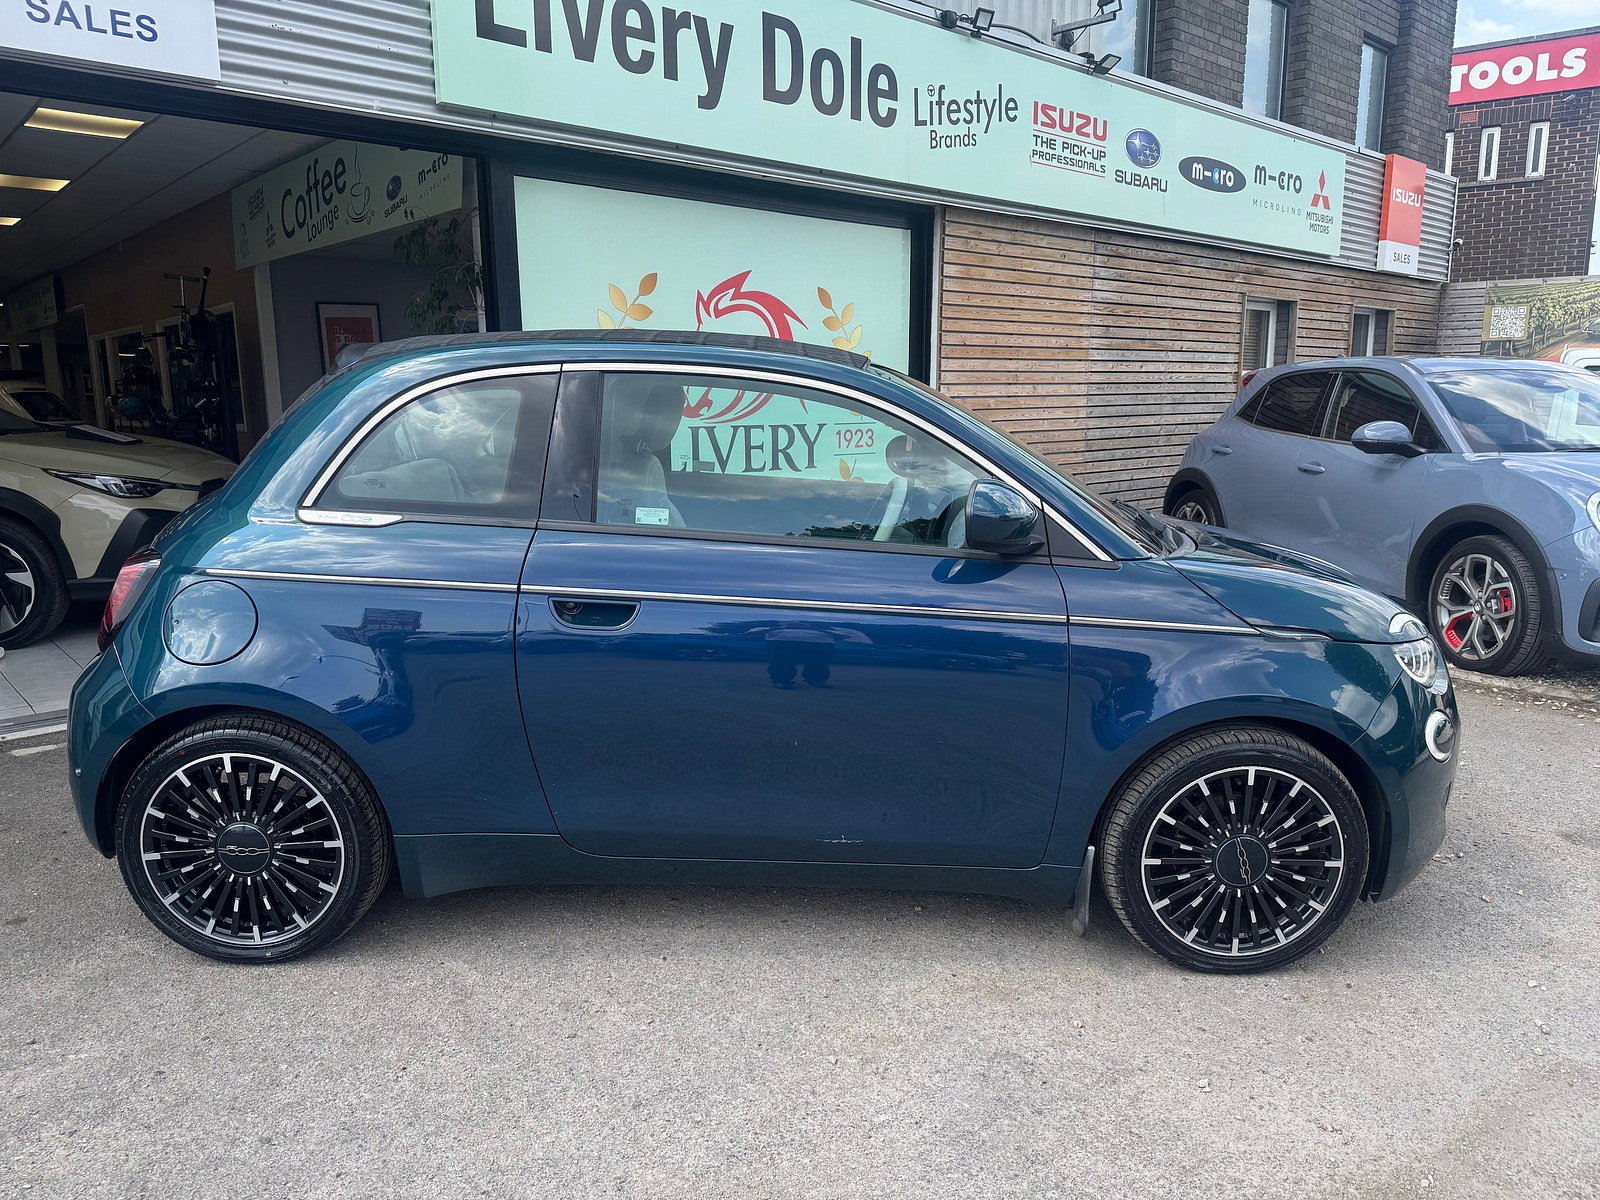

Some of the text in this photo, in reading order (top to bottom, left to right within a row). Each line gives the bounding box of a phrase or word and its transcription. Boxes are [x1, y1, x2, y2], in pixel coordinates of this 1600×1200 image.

[25, 0, 159, 42] SALES
[761, 11, 899, 128] Dole
[1450, 47, 1588, 93] TOOLS
[913, 83, 1019, 133] Lifestyle
[1032, 100, 1108, 142] ISUZU
[930, 128, 977, 150] Brands
[1032, 134, 1107, 161] THE PICK-UP
[1031, 148, 1106, 174] PROFESSIONALS
[1114, 168, 1168, 193] SUBARU
[281, 156, 347, 239] Coffee
[384, 194, 408, 218] SUBARU
[1252, 198, 1303, 217] MICROLINO
[1392, 187, 1421, 208] ISUZU
[307, 204, 339, 242] Lounge
[1305, 210, 1334, 226] MITSUBISHI
[1309, 222, 1330, 235] MOTORS
[1392, 251, 1411, 265] SALES
[680, 421, 875, 474] IVERY 1923
